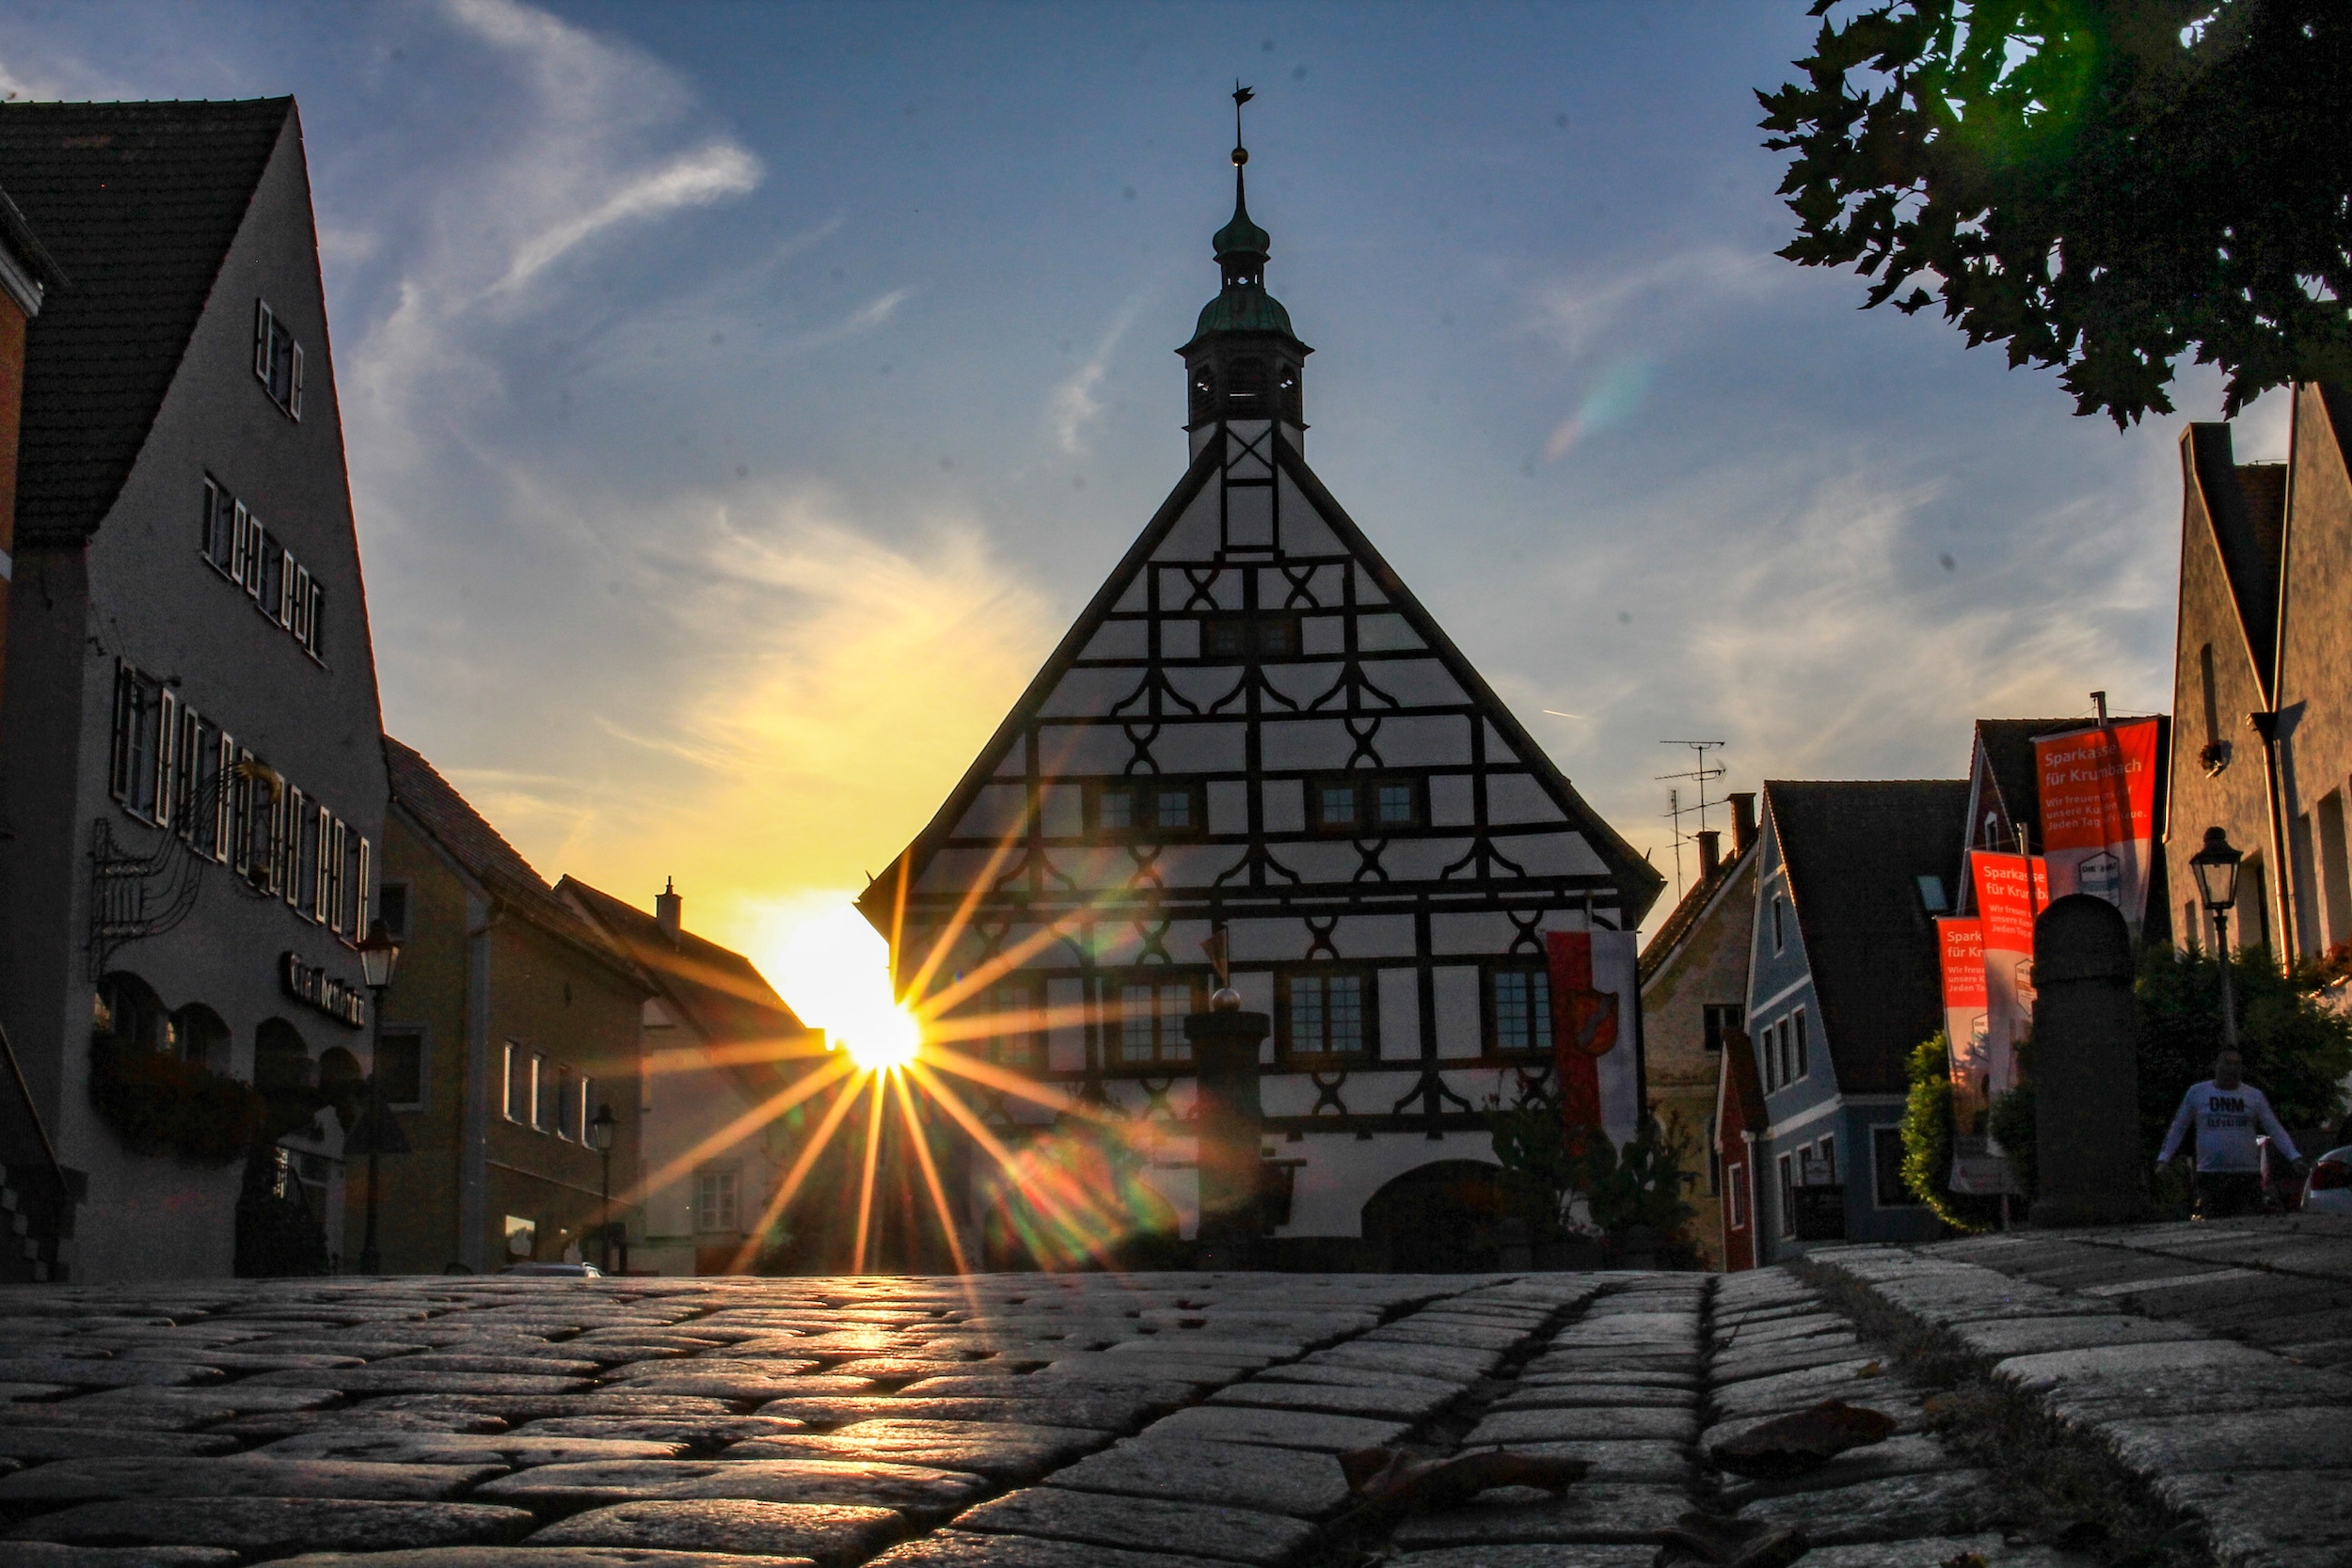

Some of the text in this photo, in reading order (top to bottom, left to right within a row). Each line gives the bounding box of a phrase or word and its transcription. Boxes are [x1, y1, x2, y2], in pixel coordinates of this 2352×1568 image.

[2044, 744, 2116, 768] Sparkasse
[2045, 758, 2141, 786] für Krumbach
[2046, 797, 2062, 808] Wir
[2065, 794, 2101, 804] freuen
[2046, 806, 2082, 819] unsere
[2048, 818, 2079, 831] Jeden
[2081, 816, 2101, 828] Tag
[1986, 882, 2005, 895] für
[1988, 904, 2003, 912] Wir
[1990, 915, 2017, 925] unsere
[1992, 924, 2015, 934] Jeden
[1947, 930, 1982, 943] Spark
[1947, 946, 1983, 958] für Kr
[1947, 966, 1963, 974] Wir
[1948, 983, 1974, 992] Jeden
[2210, 1097, 2245, 1112] DNM
